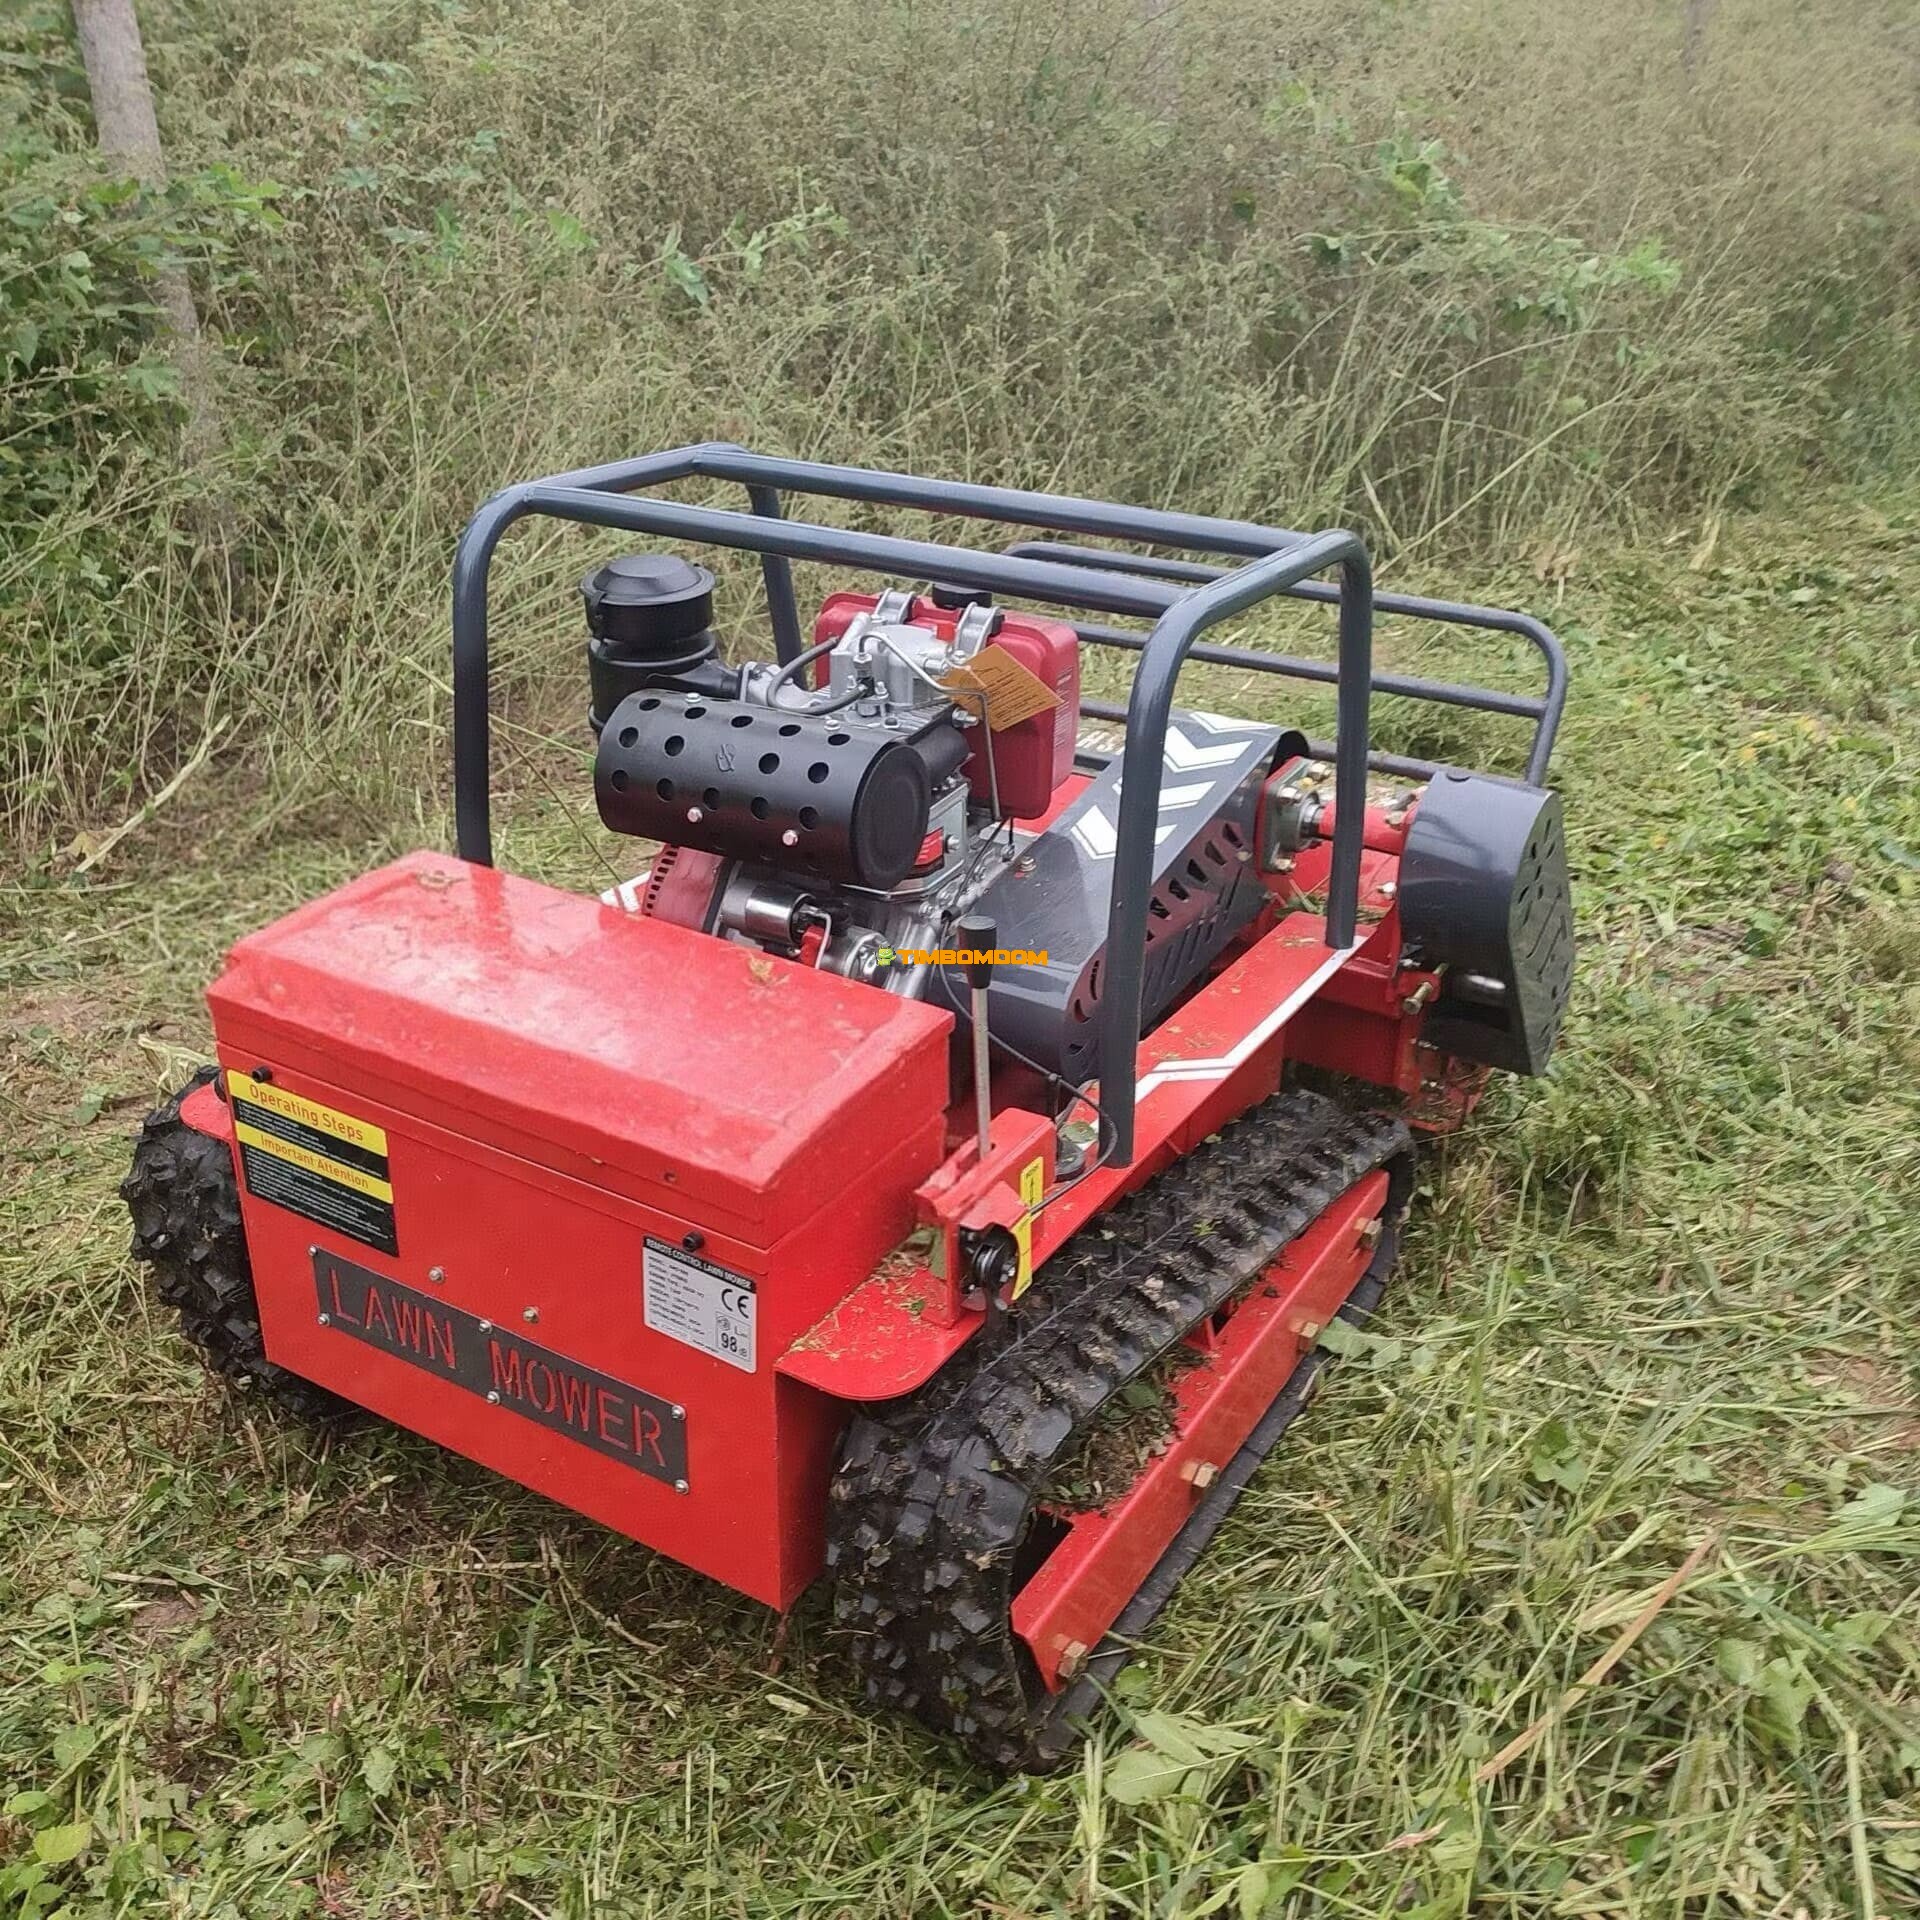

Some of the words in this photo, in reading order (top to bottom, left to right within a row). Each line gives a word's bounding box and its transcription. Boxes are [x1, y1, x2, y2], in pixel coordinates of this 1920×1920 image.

[249, 1083, 320, 1126] Operating
[322, 1113, 364, 1141] Steps
[260, 1134, 315, 1166] Important
[317, 1157, 370, 1189] Attention
[672, 1248, 703, 1268] CONTROL
[329, 1267, 456, 1370] LAWN
[489, 1339, 666, 1467] MOWER
[721, 1332, 738, 1352] 98
